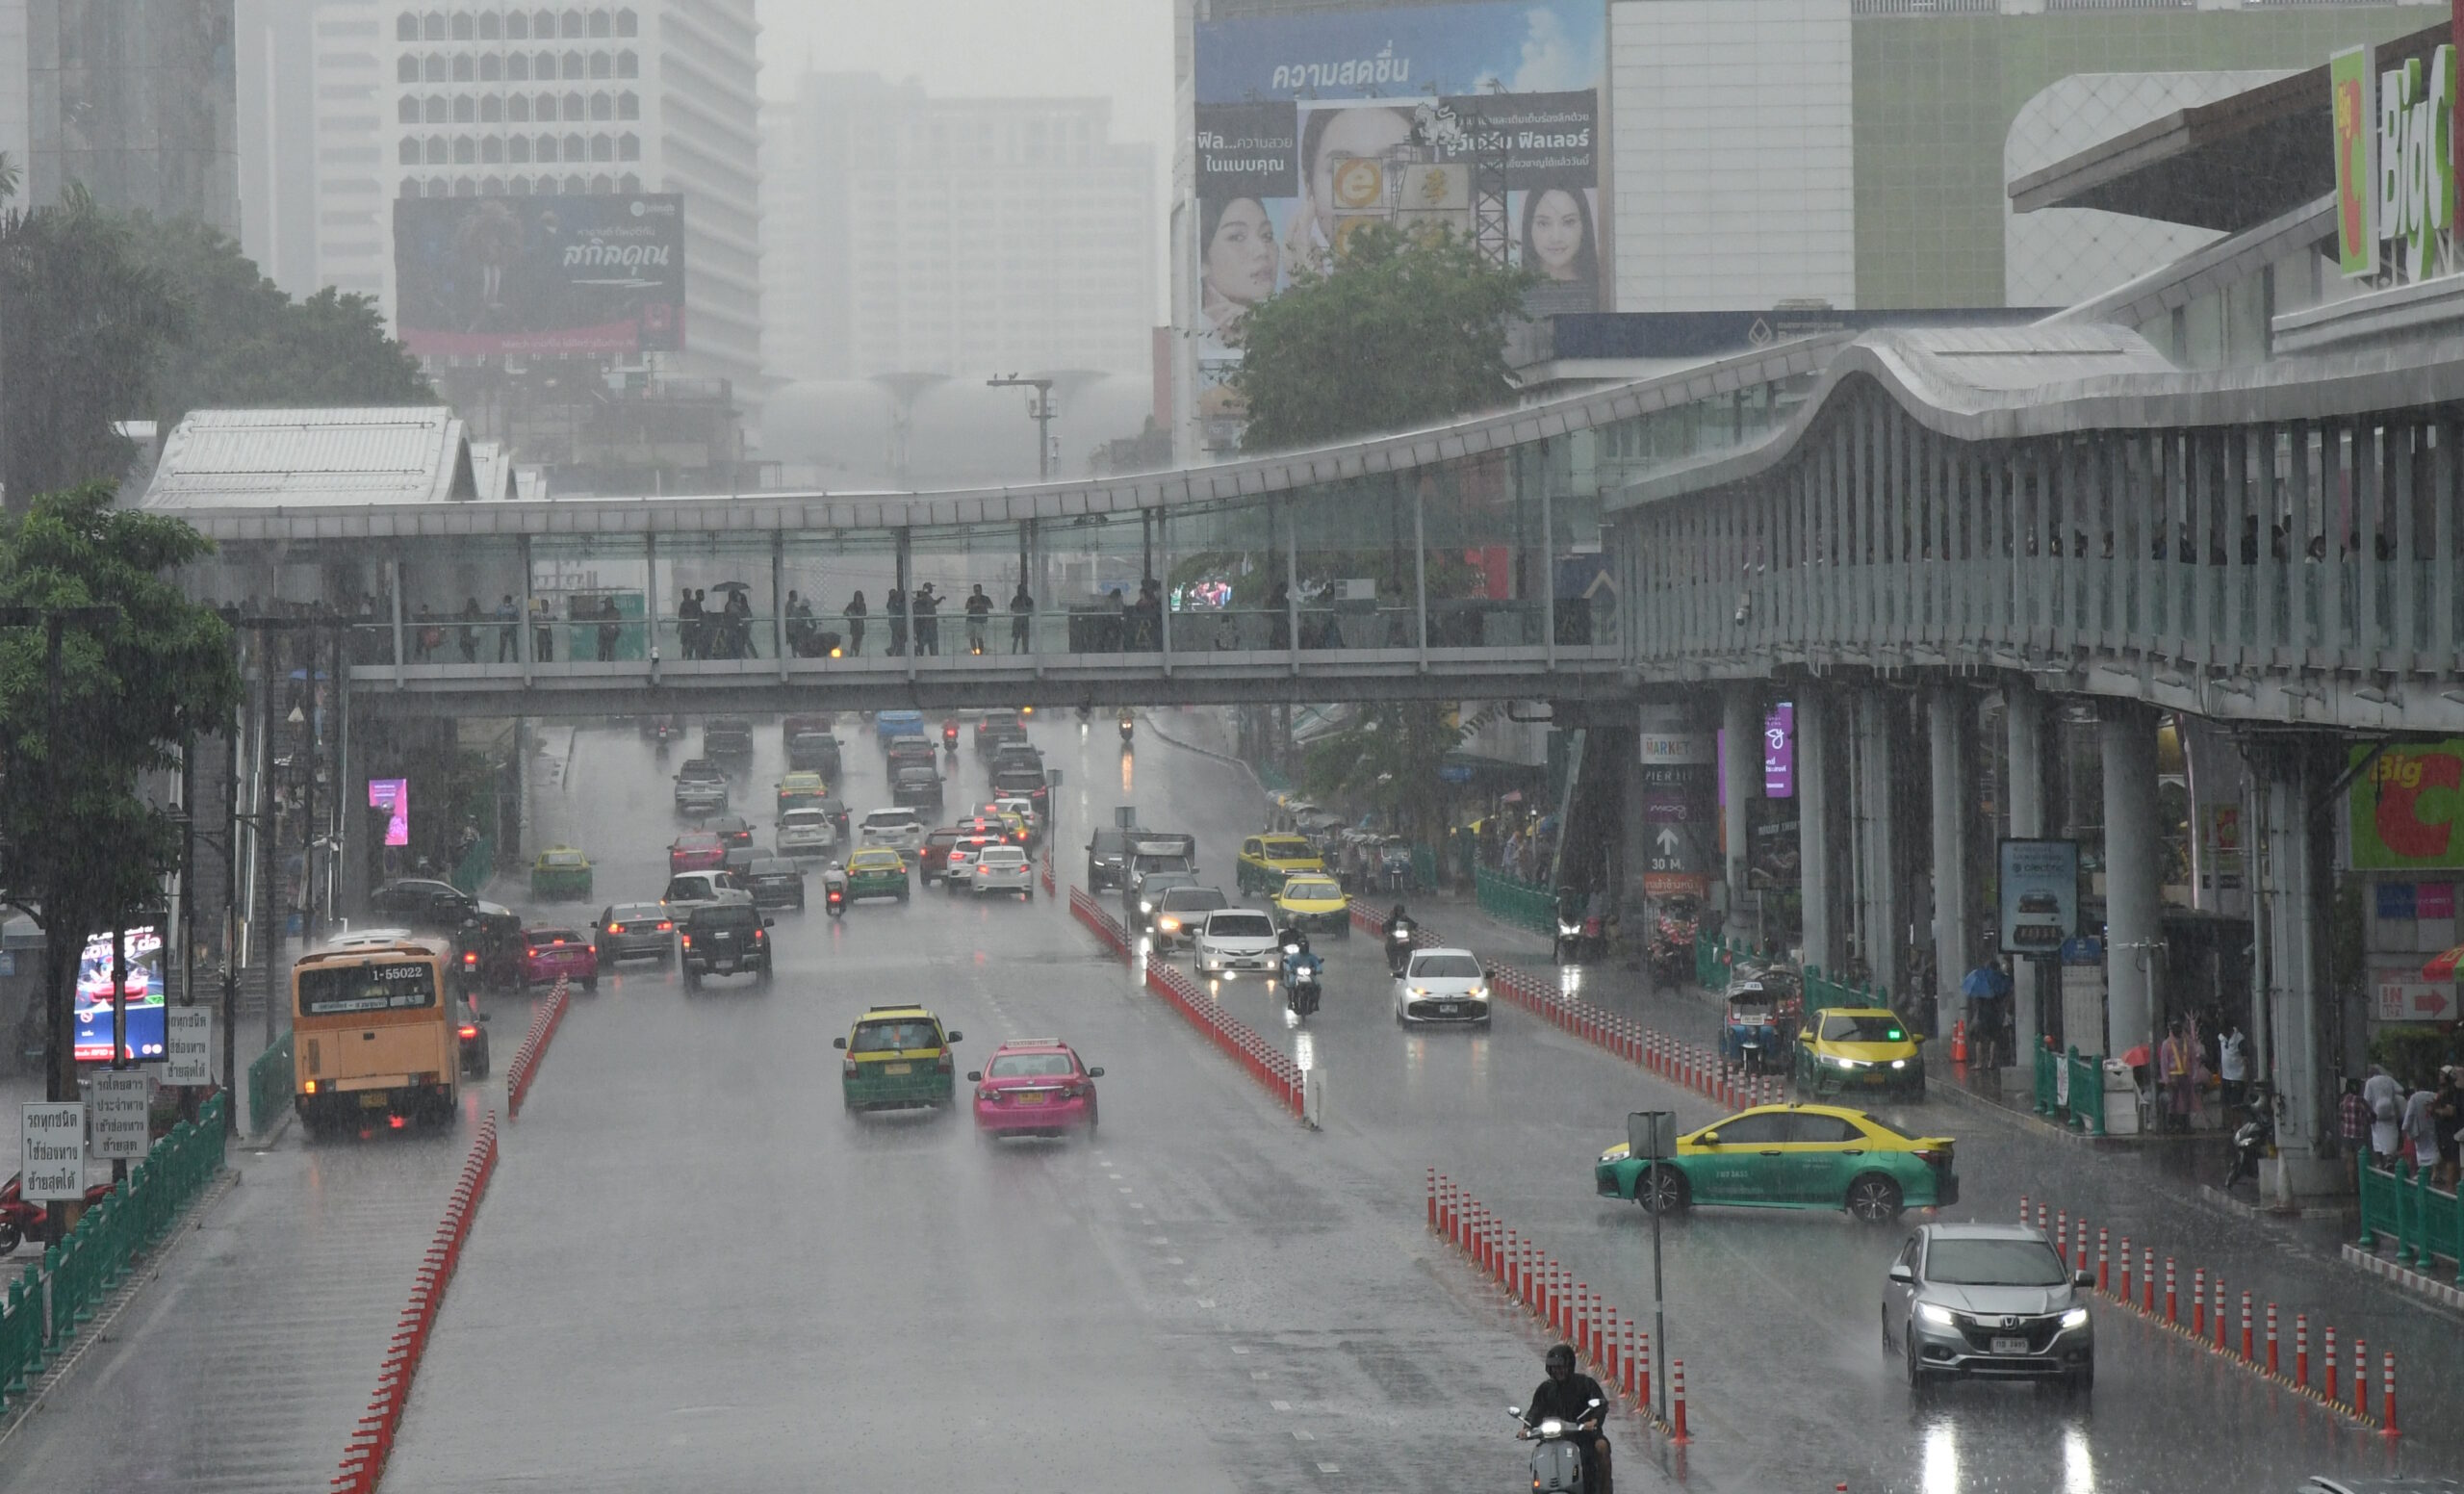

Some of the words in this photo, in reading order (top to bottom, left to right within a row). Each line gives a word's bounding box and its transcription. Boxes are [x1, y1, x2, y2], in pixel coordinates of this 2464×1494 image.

[1271, 39, 1410, 90] ความสดชื่น
[1519, 127, 1591, 150] ฟิลเลอร์
[1205, 155, 1285, 176] ในแบบคุณ
[563, 238, 670, 276] สกิลคุณ
[1647, 740, 1691, 756] MARKET
[1652, 858, 1665, 870] 30
[372, 966, 423, 981] 1-55022
[169, 1013, 207, 1032] ถทุกชนิด
[169, 1039, 206, 1054] ช้ช่องทาง
[97, 1074, 143, 1092] รถโดยสาร
[97, 1097, 143, 1112] ประจำทาง
[28, 1110, 77, 1132] รถทุกชนิด
[27, 1138, 78, 1161] ใช้ช่องทาง
[28, 1168, 76, 1194] ซ้ายสุดได้
